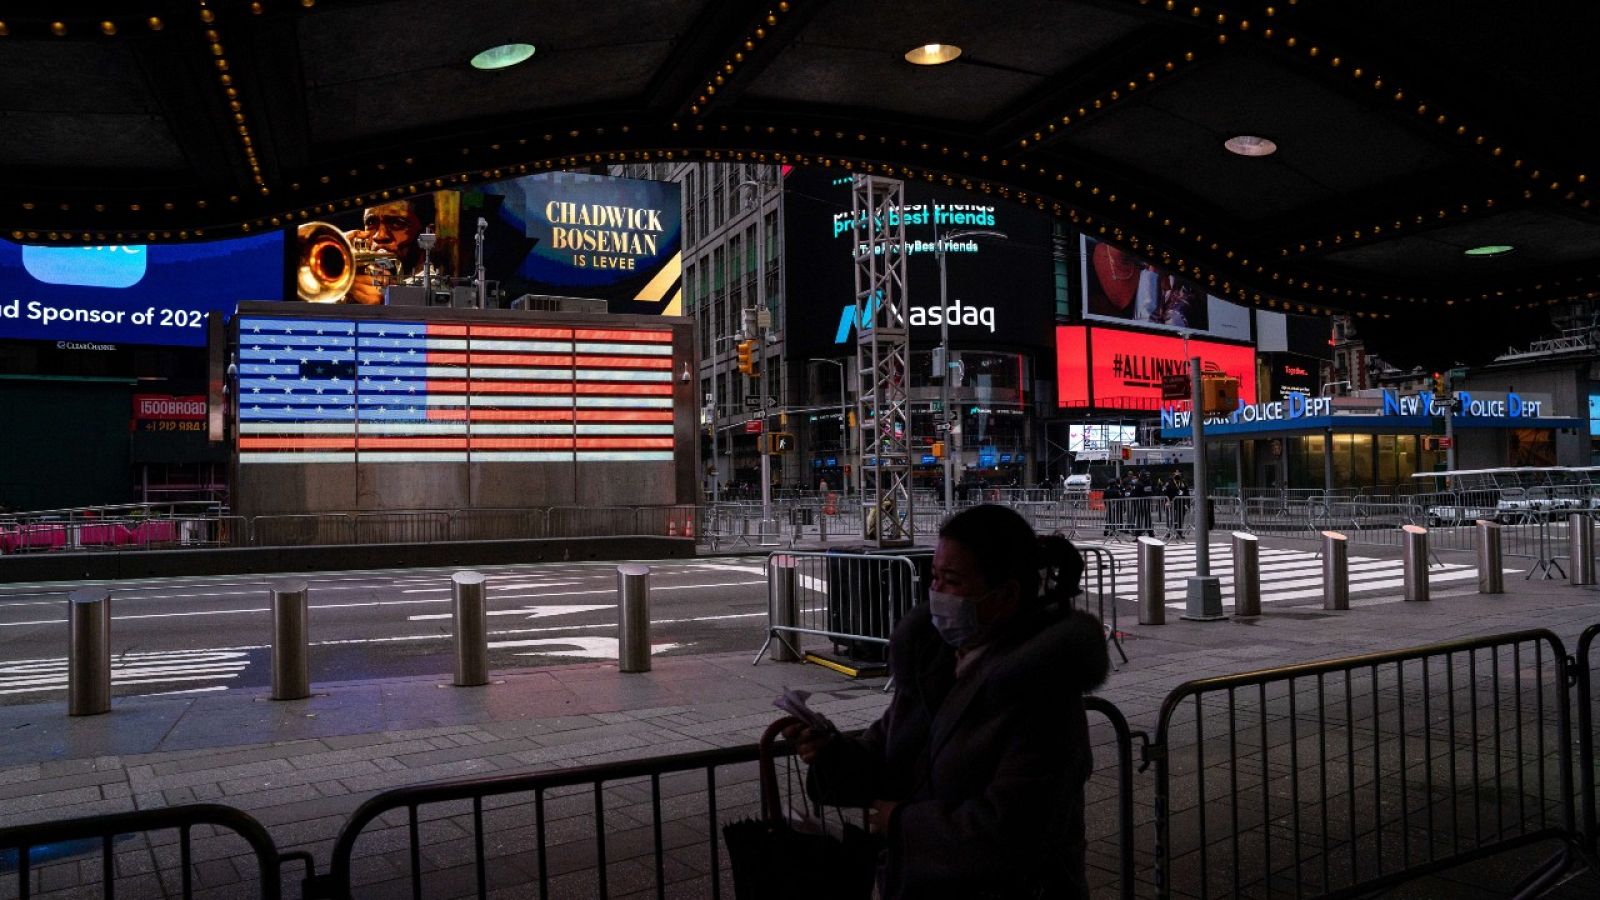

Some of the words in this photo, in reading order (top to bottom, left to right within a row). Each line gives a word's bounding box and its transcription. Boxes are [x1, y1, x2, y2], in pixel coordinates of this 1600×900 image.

[546, 201, 663, 231] CHADWICK
[553, 227, 657, 255] BOSEMAN
[574, 255, 586, 267] IS
[593, 256, 635, 271] LEVEE
[27, 301, 126, 325] Sponsor
[131, 307, 155, 326] of
[1161, 406, 1191, 429] NEW
[1289, 391, 1332, 418] DEPT
[1383, 390, 1419, 416] NEW
[1459, 391, 1505, 417] POLICE
[1507, 393, 1542, 417] DEPT
